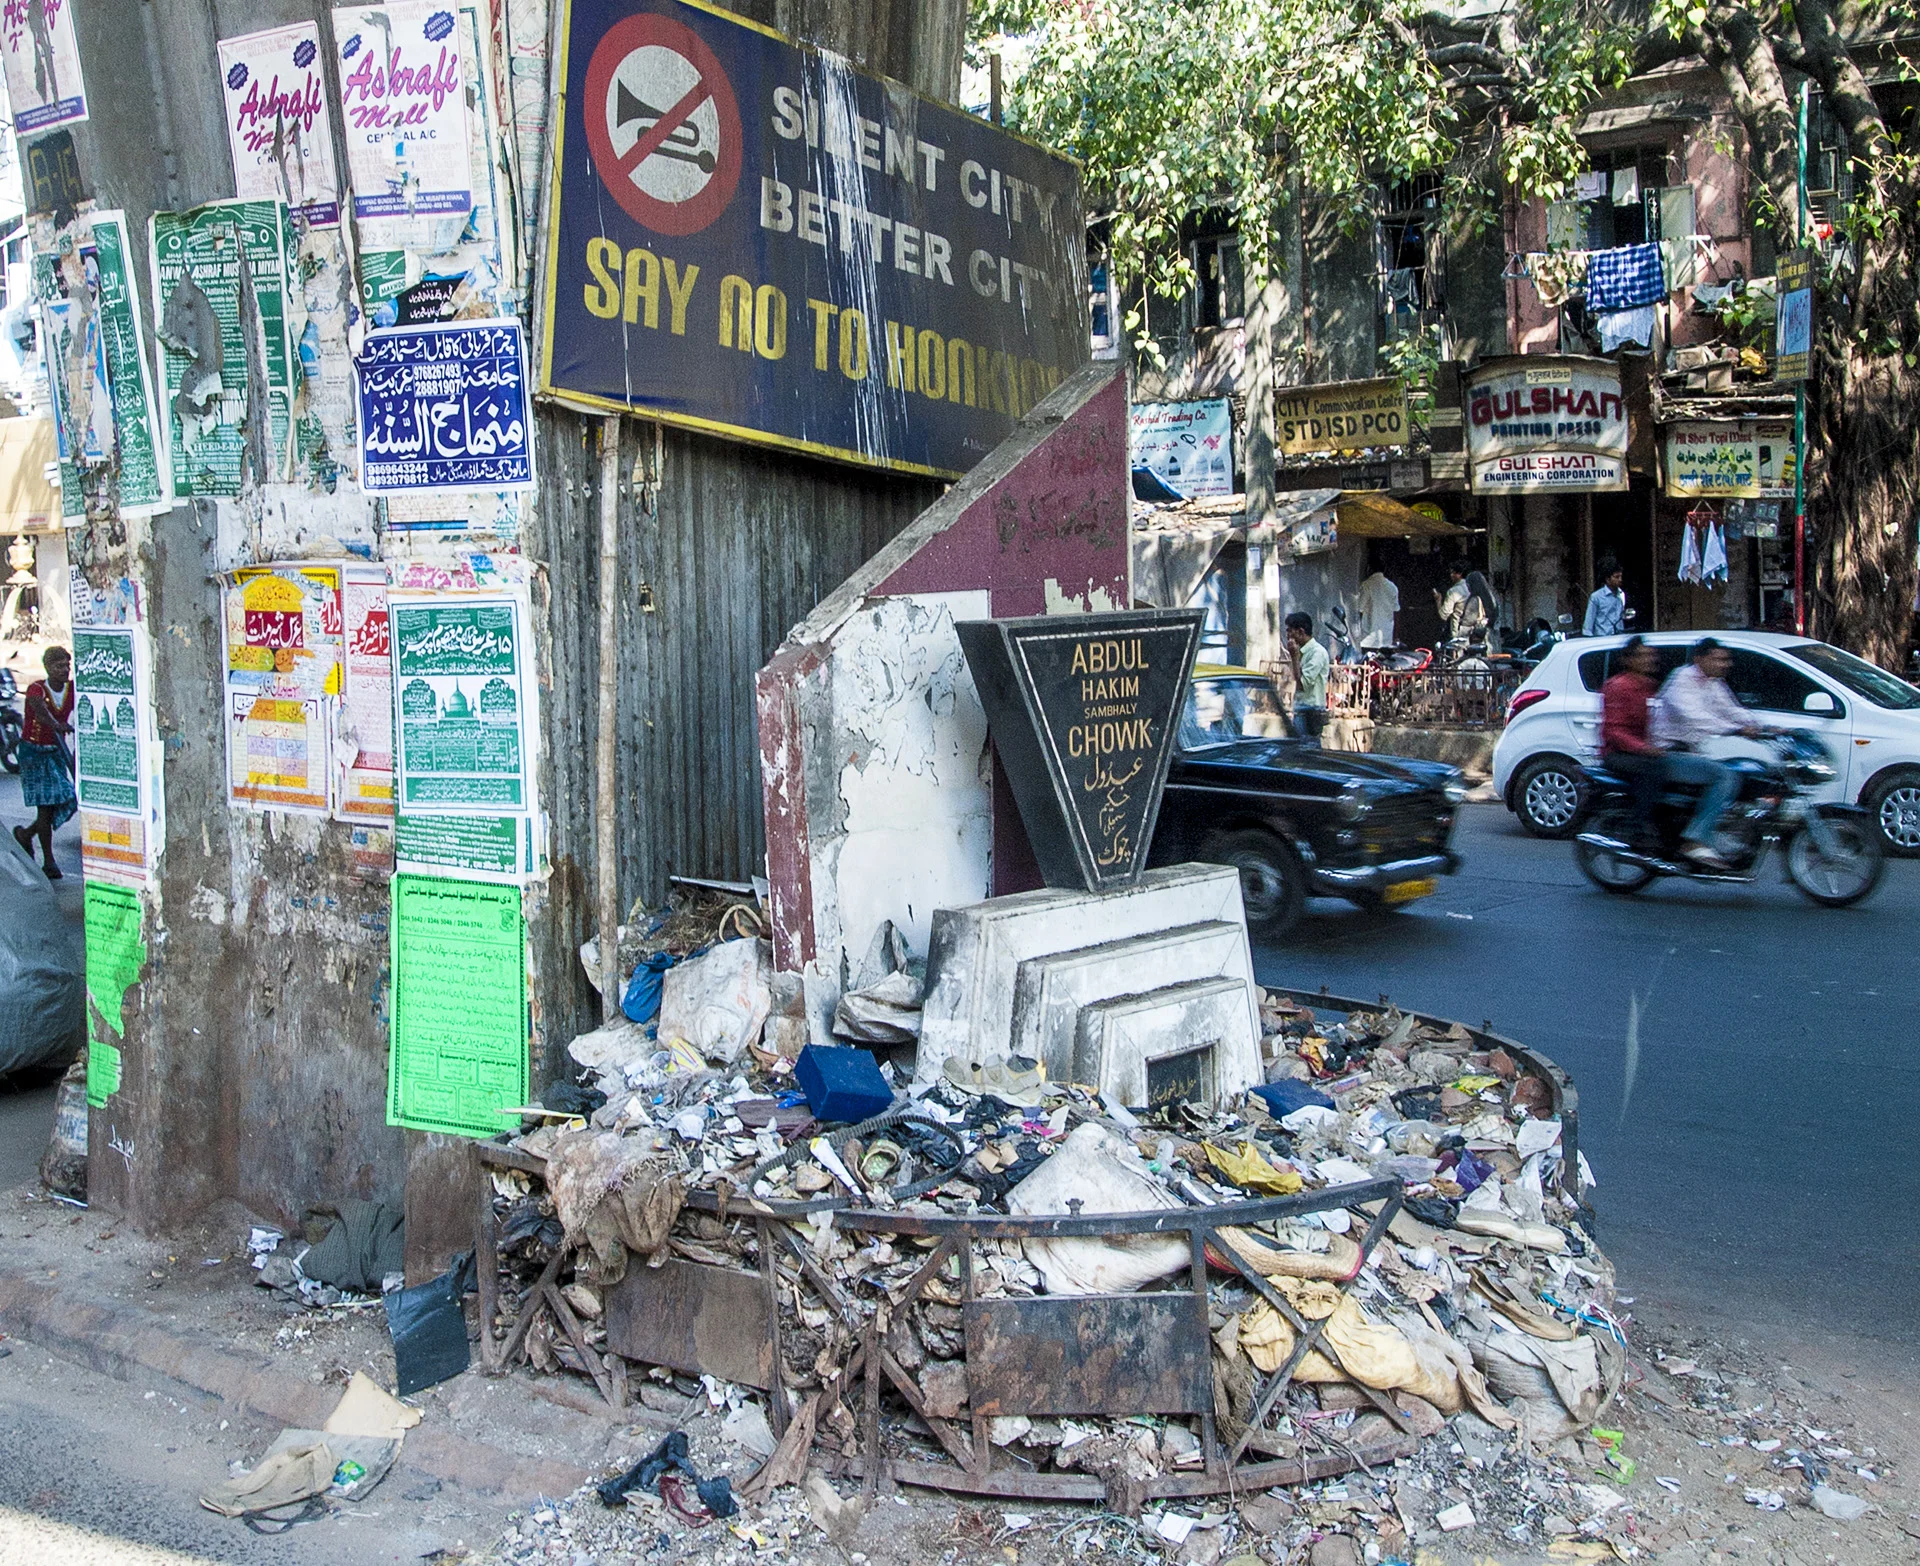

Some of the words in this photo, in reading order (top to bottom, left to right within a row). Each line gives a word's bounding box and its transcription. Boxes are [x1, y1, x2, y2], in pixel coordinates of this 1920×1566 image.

[343, 45, 458, 112] Ashrafi
[237, 71, 321, 132] Ashrafi
[772, 86, 945, 192] SILENT
[960, 159, 1056, 233] CITY
[761, 176, 954, 286] BETTER
[584, 236, 700, 335] SAY
[719, 274, 788, 361] NO
[807, 297, 868, 381] TO
[888, 320, 1069, 417] HONKIN
[413, 363, 460, 380] 9768267493
[415, 381, 461, 395] 28881907
[1162, 409, 1193, 427] Trading
[1278, 397, 1310, 417] CITY
[1314, 399, 1376, 414] Communication
[1471, 387, 1622, 426] GULSHAN
[1284, 419, 1322, 441] STD
[1326, 416, 1357, 437] ISD
[1362, 411, 1400, 435] PCO
[1491, 423, 1552, 437] PRINTING
[1558, 421, 1601, 436] PRESS
[1484, 471, 1544, 482] ENGINEERING
[1546, 469, 1614, 480] CORPORATION
[1499, 456, 1596, 471] GULSHAN
[1070, 639, 1150, 676] ABDUL
[1082, 675, 1140, 701] HAKIM
[1084, 703, 1138, 719] SAMBHALY
[1068, 717, 1153, 758] CHOWK
